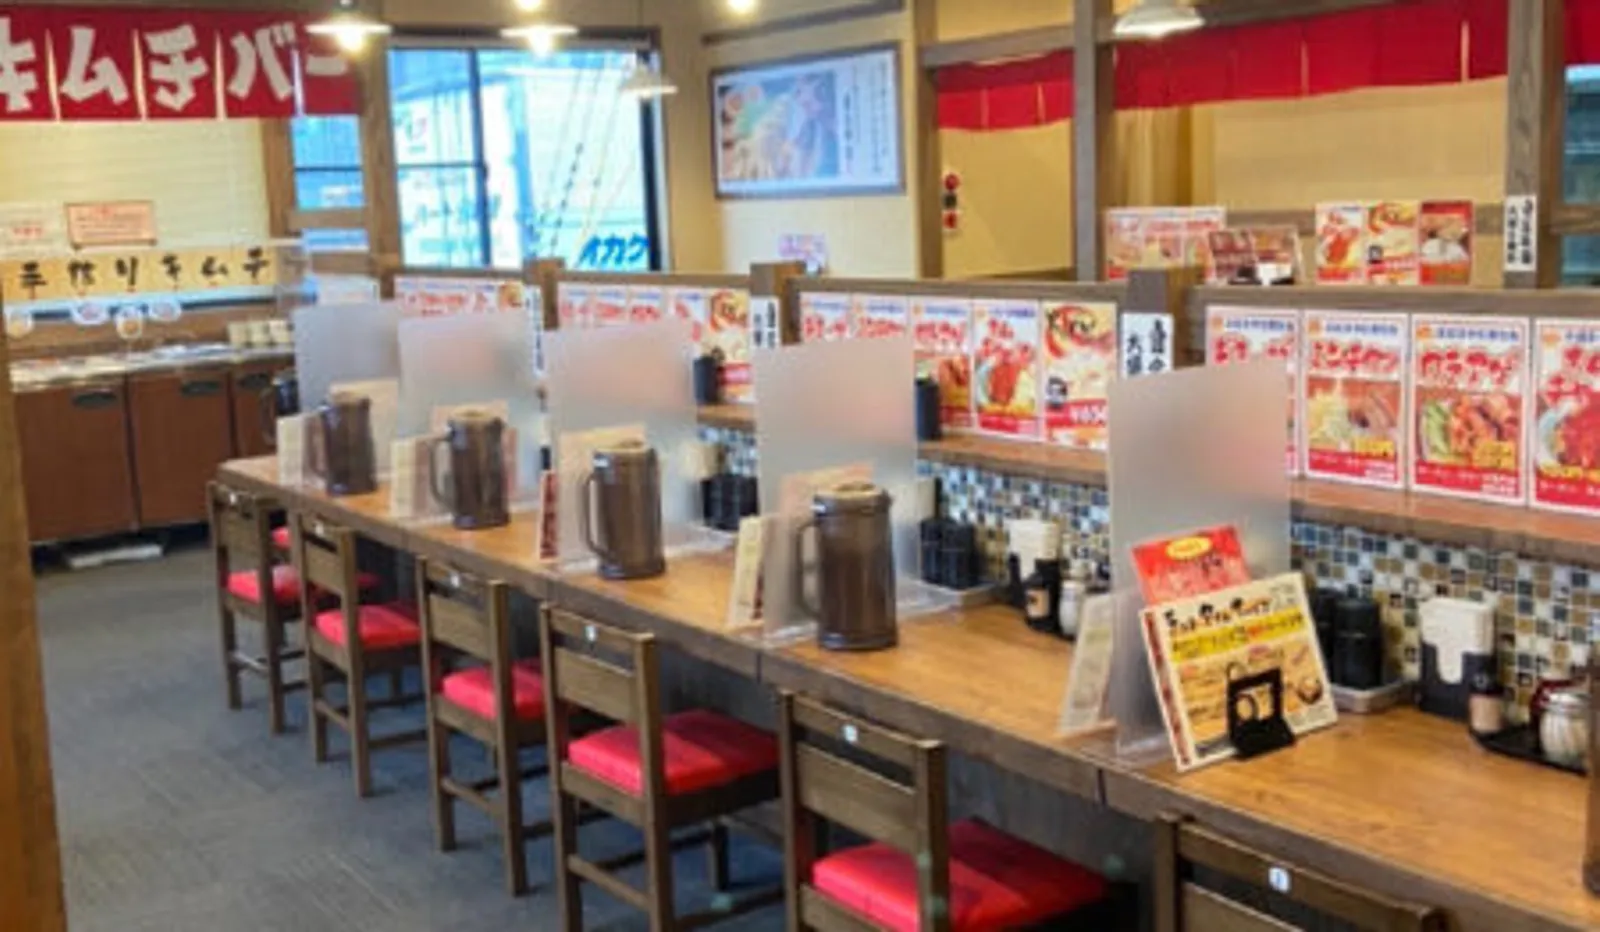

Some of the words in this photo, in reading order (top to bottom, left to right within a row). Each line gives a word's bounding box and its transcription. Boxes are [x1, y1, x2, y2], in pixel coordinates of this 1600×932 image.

[0, 17, 349, 112] キムチバー
[20, 247, 270, 297] 手作りキムチ
